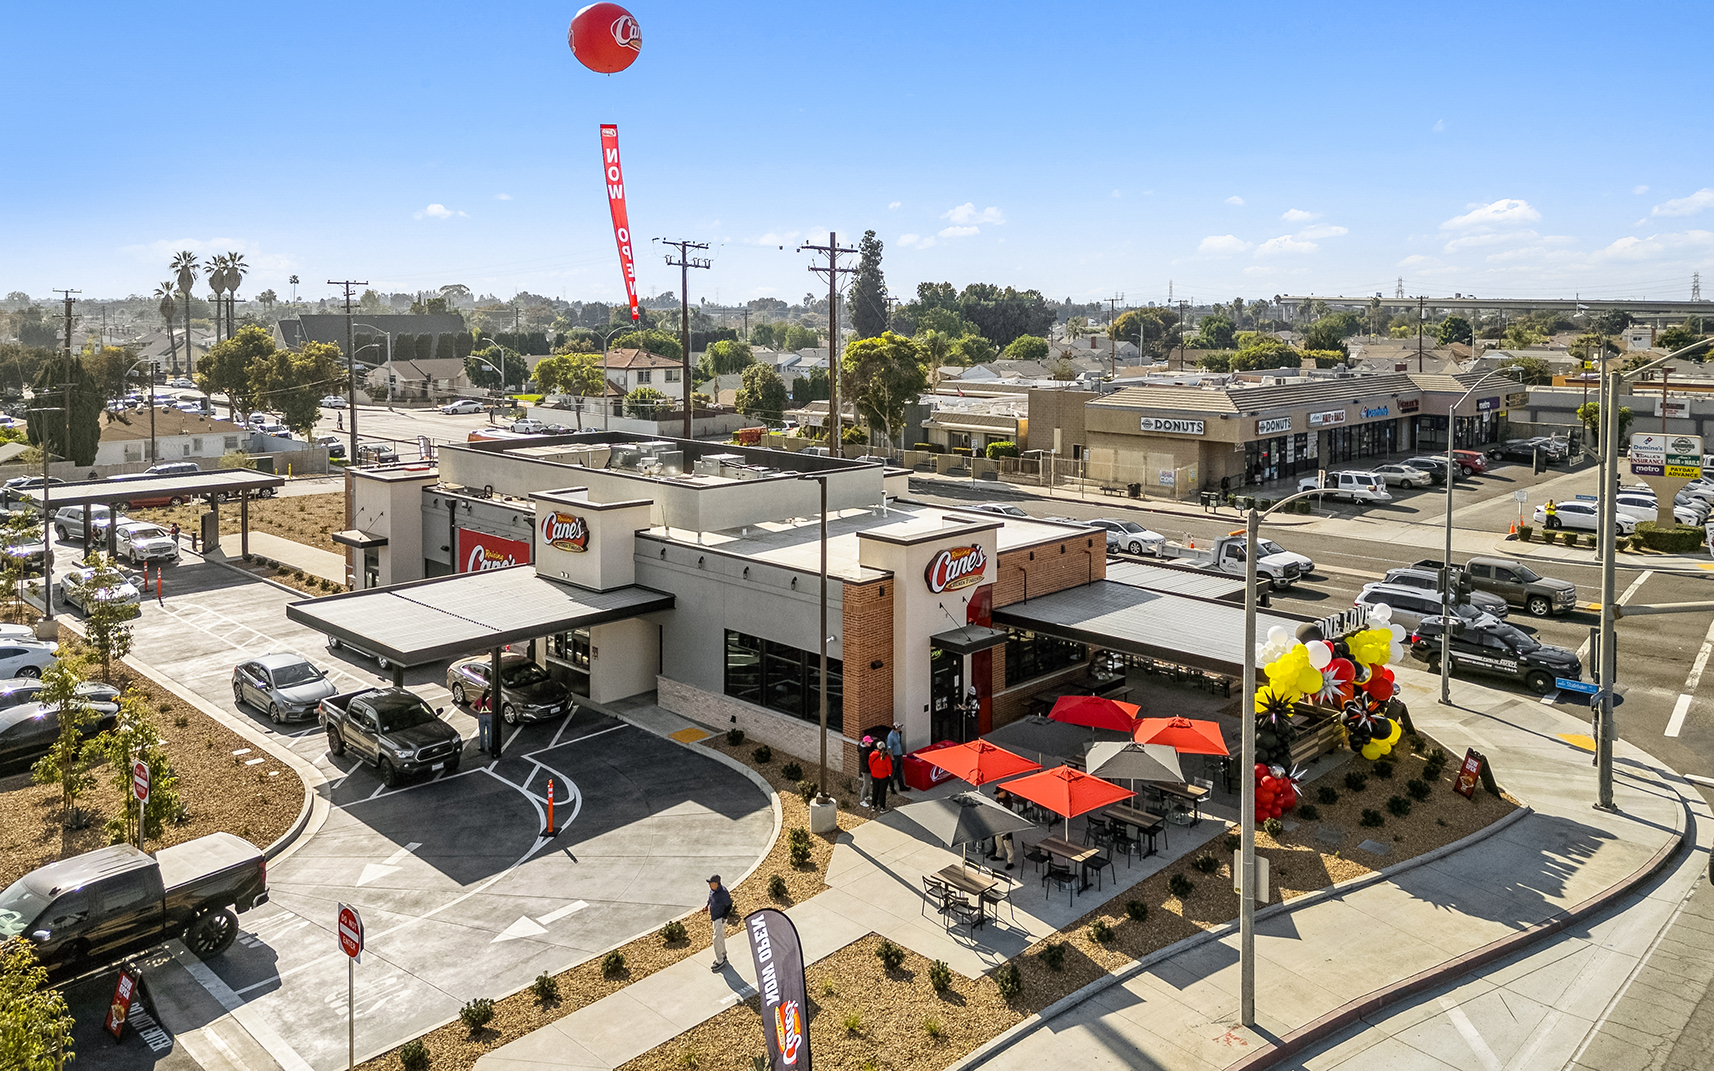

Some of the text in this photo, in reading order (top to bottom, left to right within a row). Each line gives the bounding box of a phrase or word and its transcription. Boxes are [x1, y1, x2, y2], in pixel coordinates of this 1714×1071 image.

[1154, 418, 1204, 433] DONUTS
[1265, 416, 1292, 433] DONUTS
[1633, 444, 1663, 452] Domino's
[1631, 457, 1664, 465] INSURANCE
[1635, 465, 1660, 473] metro
[543, 511, 585, 545] Cane's
[485, 549, 504, 563] Raising
[931, 544, 987, 593] Cane's
[1343, 604, 1371, 634] LOVE
[136, 783, 146, 794] ENTER
[341, 913, 357, 931] DO NOT
[342, 935, 356, 952] ENTER
[118, 983, 131, 1000] OPEN
[127, 1002, 174, 1053] DO NOT ENTER
